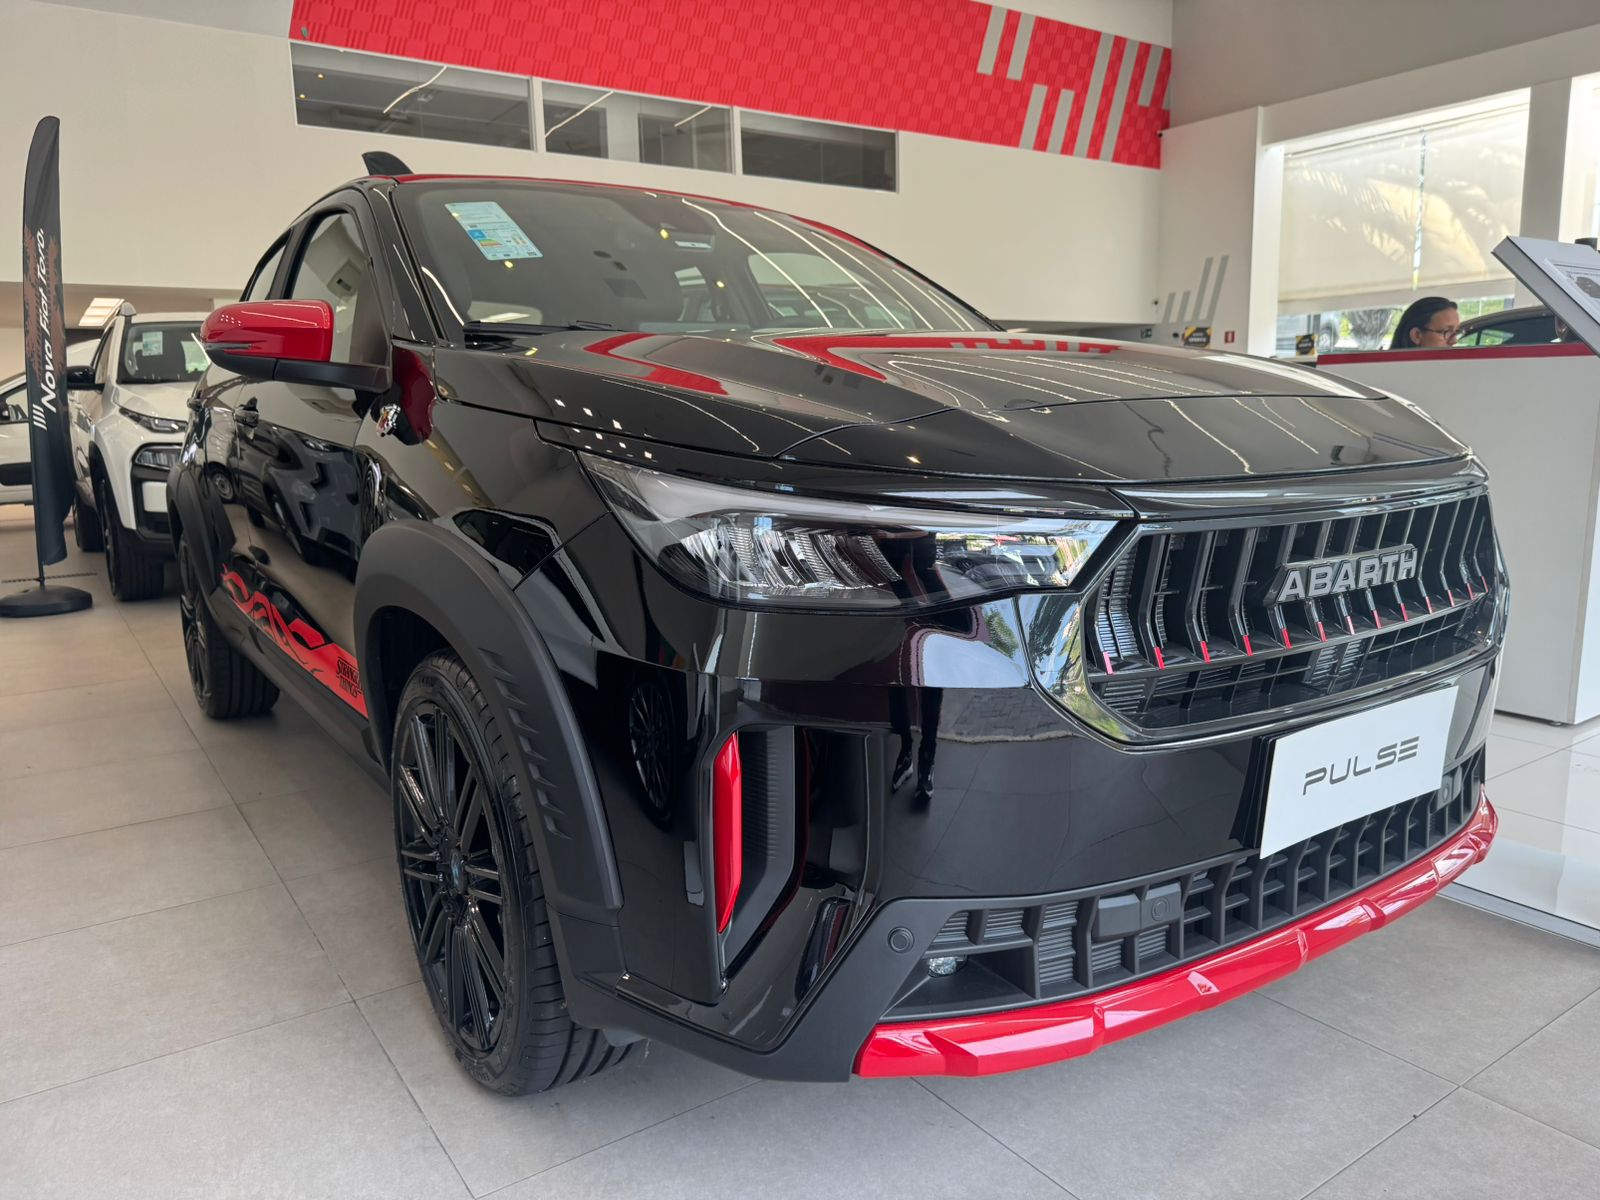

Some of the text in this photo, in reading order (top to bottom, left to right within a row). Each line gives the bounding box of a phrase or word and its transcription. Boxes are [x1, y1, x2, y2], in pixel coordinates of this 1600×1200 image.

[39, 286, 49, 336] Fiat
[41, 339, 57, 413] Nova
[1277, 548, 1418, 602] ABARTH
[1302, 736, 1420, 796] PULSE
